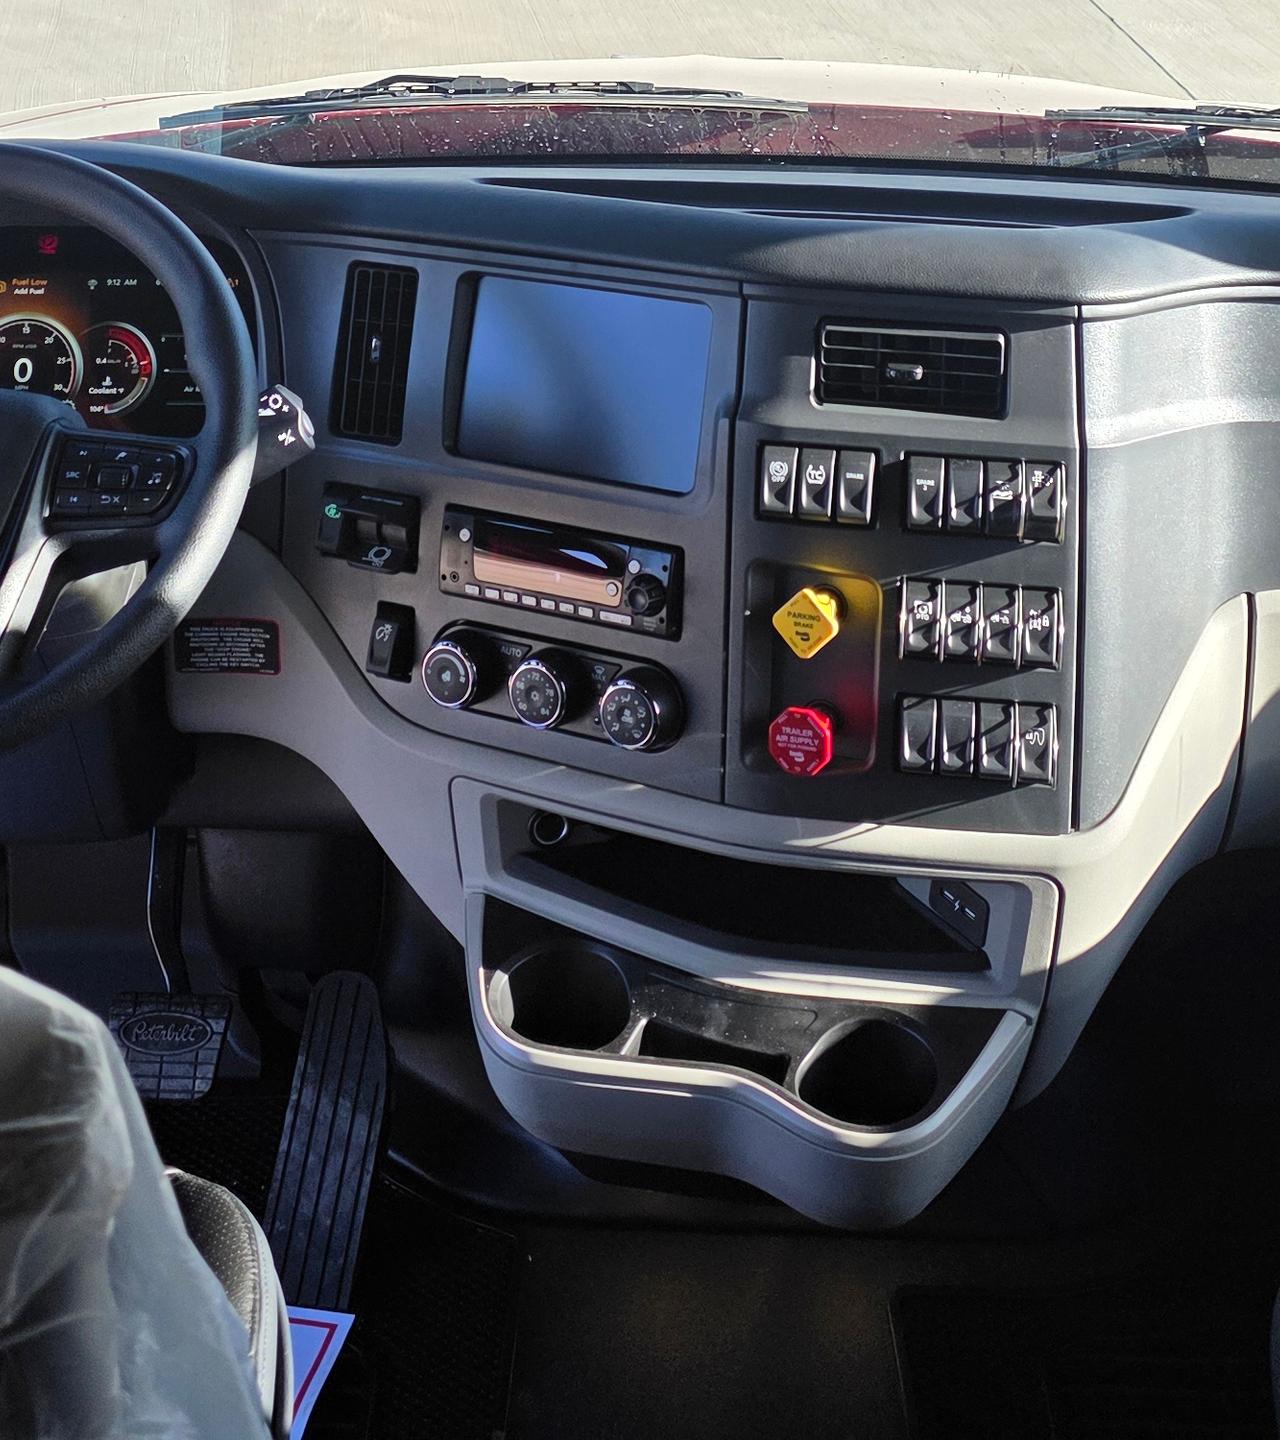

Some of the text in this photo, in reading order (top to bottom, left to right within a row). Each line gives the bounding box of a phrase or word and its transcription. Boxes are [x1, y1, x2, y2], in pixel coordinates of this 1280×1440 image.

[12, 278, 29, 286] Fuel
[22, 326, 31, 334] 15
[44, 336, 54, 344] 20
[13, 357, 33, 383] 0
[53, 383, 63, 391] 30
[65, 471, 80, 479] SRC
[810, 470, 823, 480] TC
[916, 478, 935, 487] SPARE
[786, 610, 821, 622] PARKING
[793, 621, 814, 629] BRAKE
[500, 645, 521, 657] AUTO
[531, 671, 540, 681] 72
[518, 702, 528, 711] 60
[781, 726, 813, 738] TRAILER
[776, 734, 819, 747] AIR SUPPLY
[131, 1020, 203, 1042] Peterbilt
